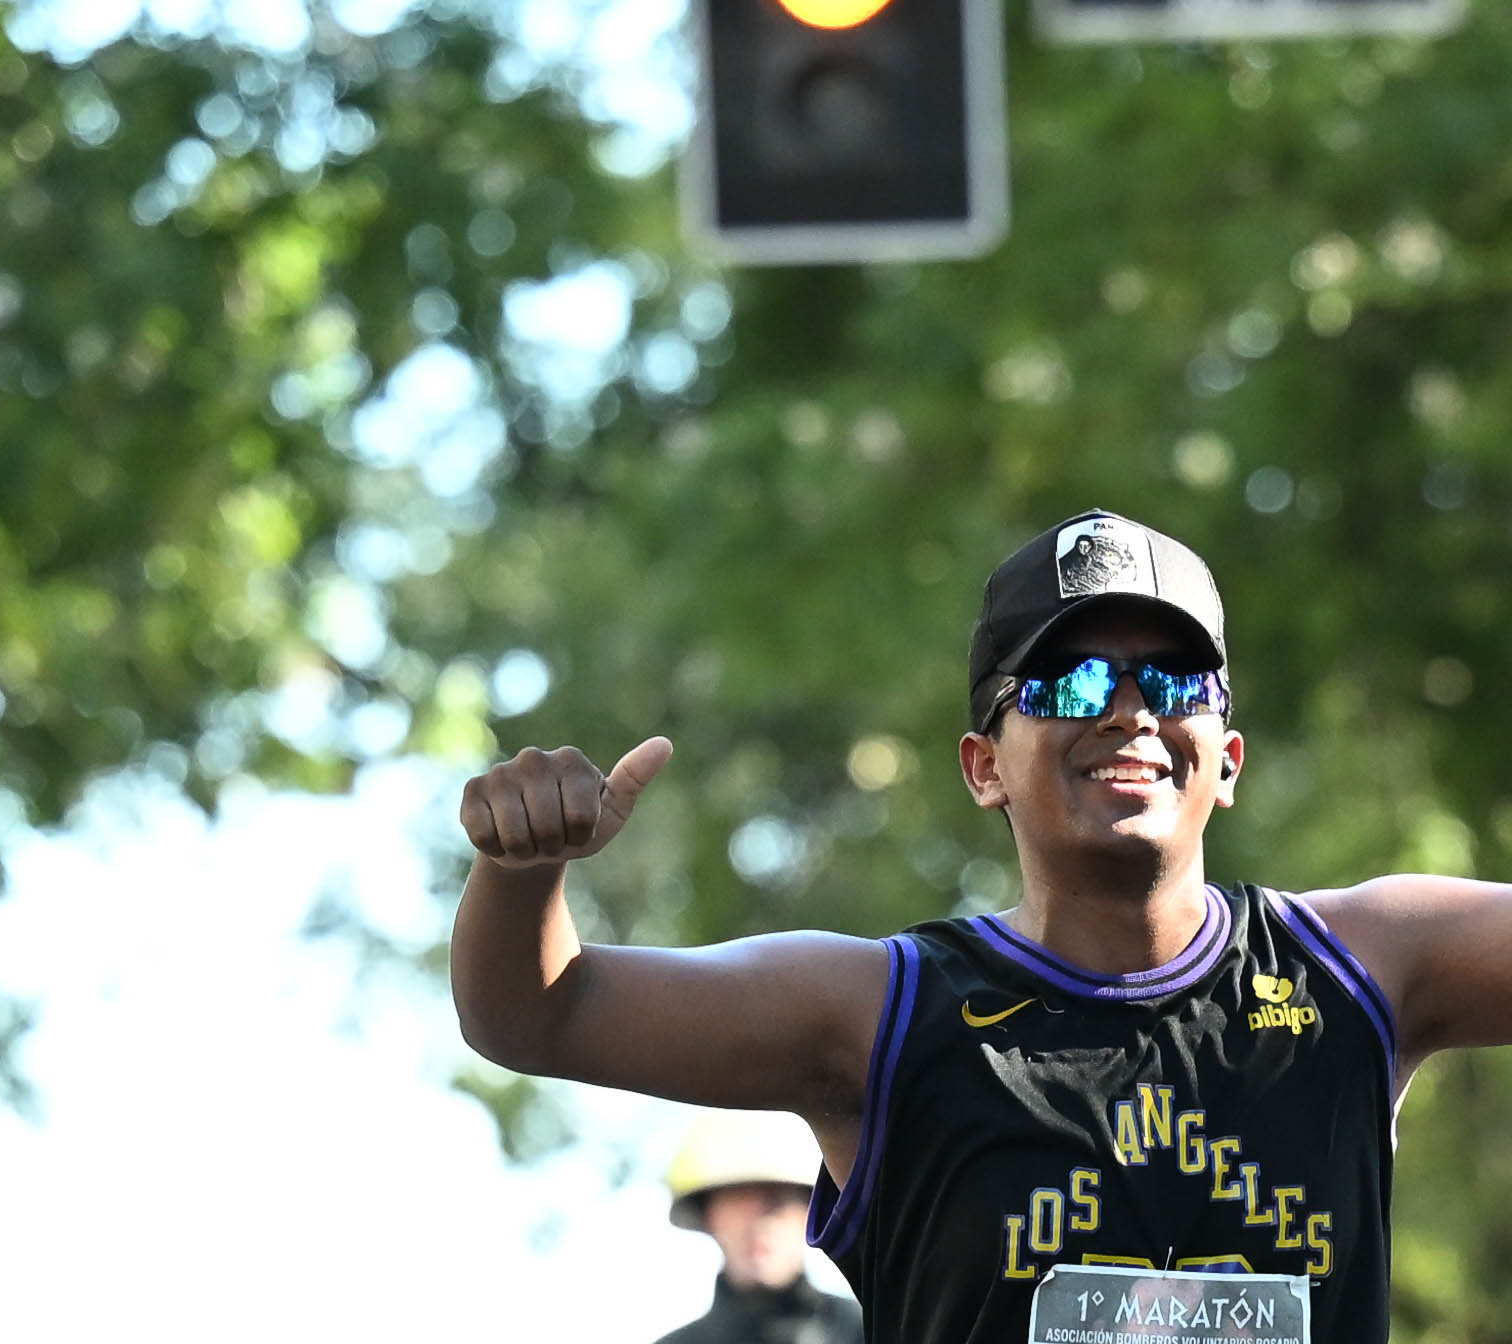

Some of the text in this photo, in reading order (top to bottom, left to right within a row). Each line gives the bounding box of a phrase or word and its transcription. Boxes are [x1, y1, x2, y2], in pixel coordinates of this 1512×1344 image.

[1002, 1083, 1333, 1280] LOS ANGELES
[1114, 1288, 1275, 1329] MARATÓN
[1045, 1327, 1113, 1344] ASOCIACIÓN
